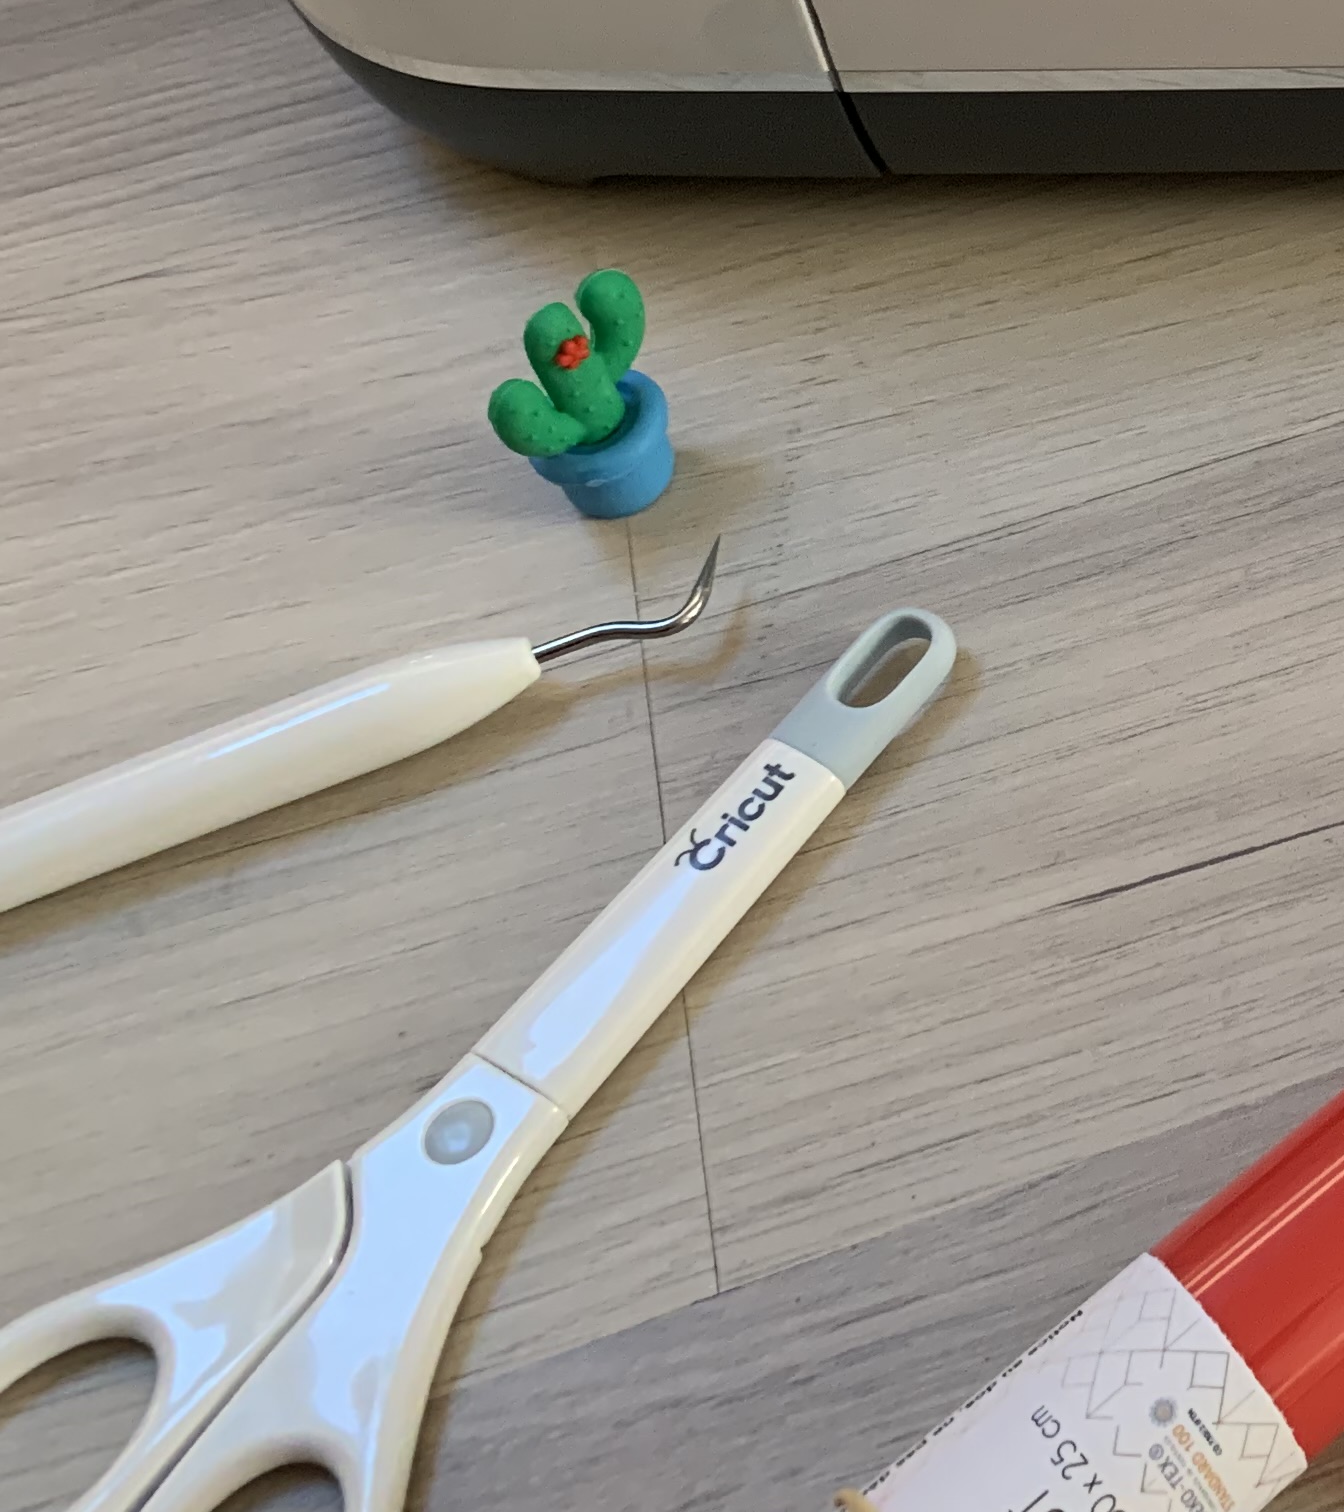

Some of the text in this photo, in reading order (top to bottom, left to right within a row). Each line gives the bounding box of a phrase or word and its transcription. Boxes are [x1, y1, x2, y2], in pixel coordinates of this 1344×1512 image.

[674, 762, 797, 871] Cricut
[1031, 1404, 1061, 1439] cm
[1050, 1439, 1089, 1481] 25
[1083, 1472, 1103, 1494] x
